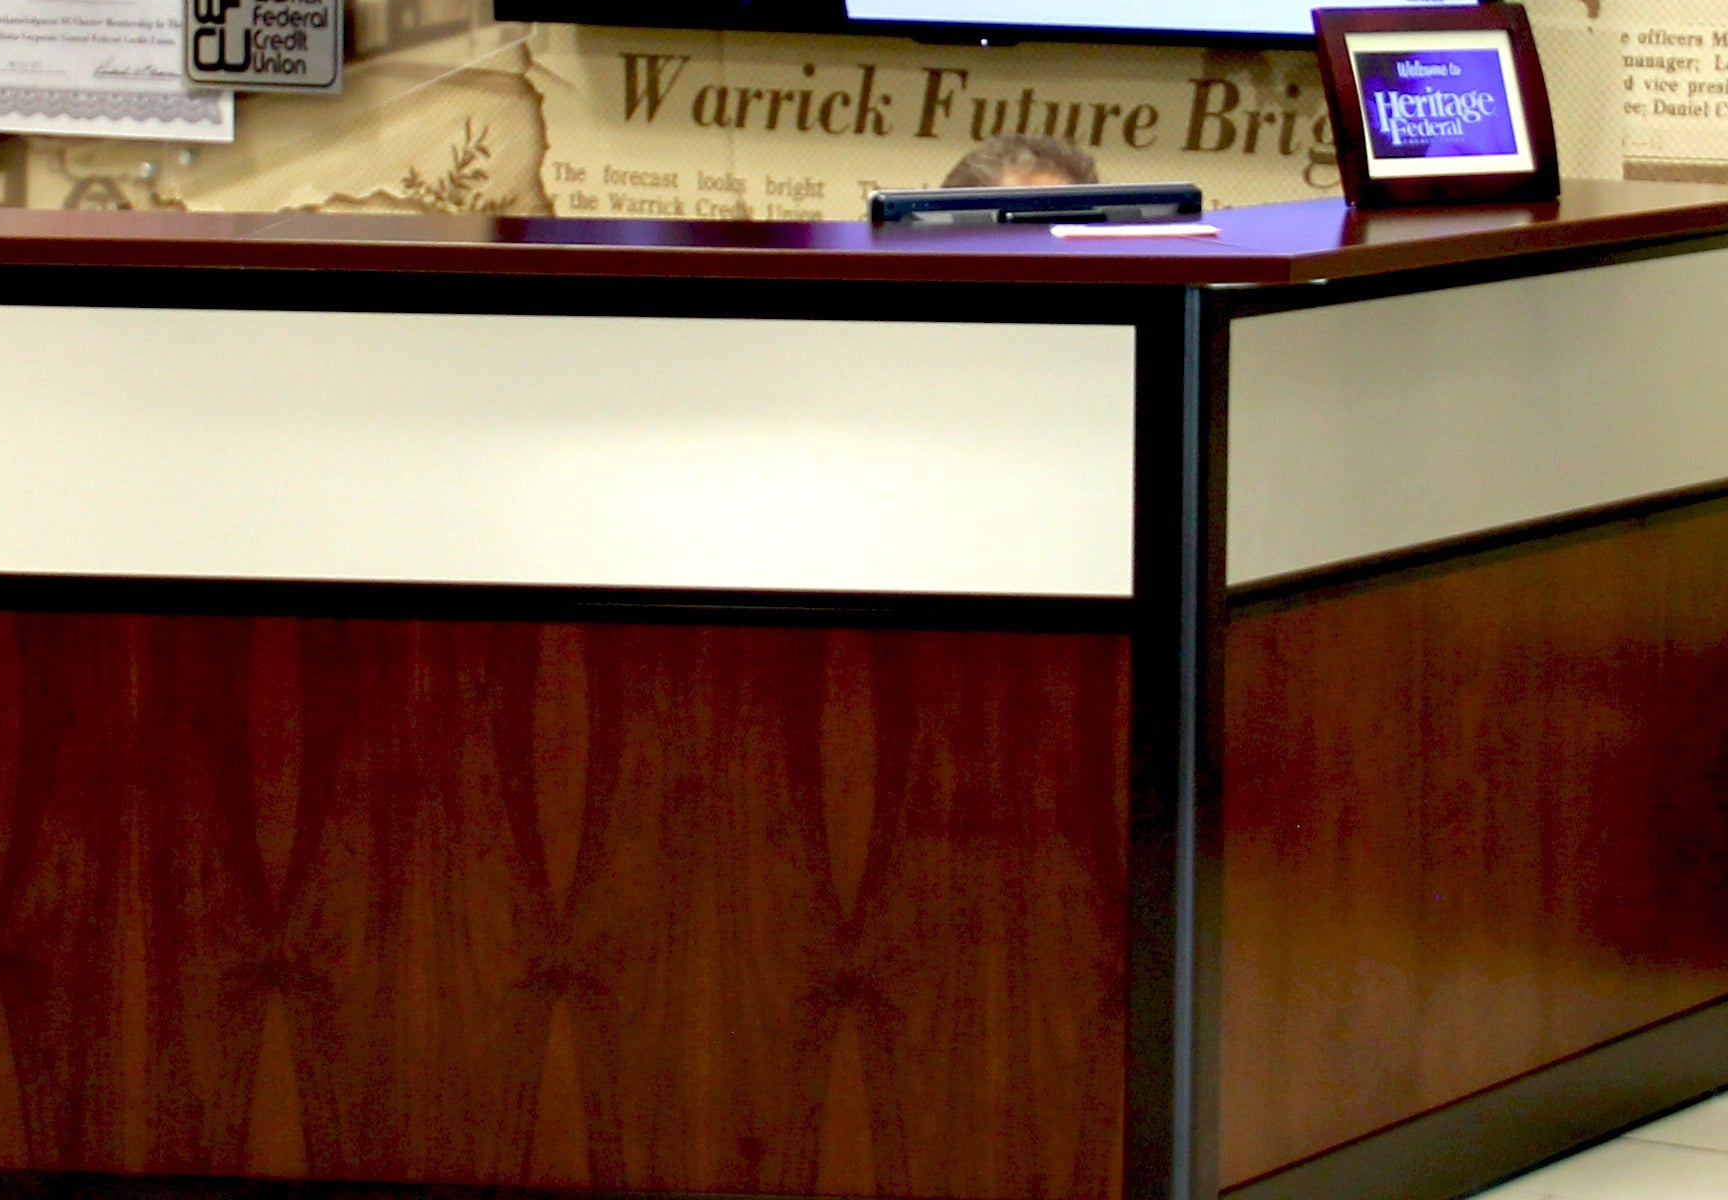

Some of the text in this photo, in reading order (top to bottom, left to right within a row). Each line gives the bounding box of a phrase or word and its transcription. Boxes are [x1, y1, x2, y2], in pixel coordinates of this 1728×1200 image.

[252, 5, 329, 28] Federal
[253, 29, 309, 51] Credit
[1637, 29, 1703, 47] officers
[252, 53, 307, 74] Union
[1396, 59, 1462, 79] Welcome to
[619, 51, 1340, 189] Warrick Future Brig
[1374, 85, 1495, 133] Heritage
[1389, 117, 1464, 146] Federal
[552, 160, 825, 200] The forecast bright
